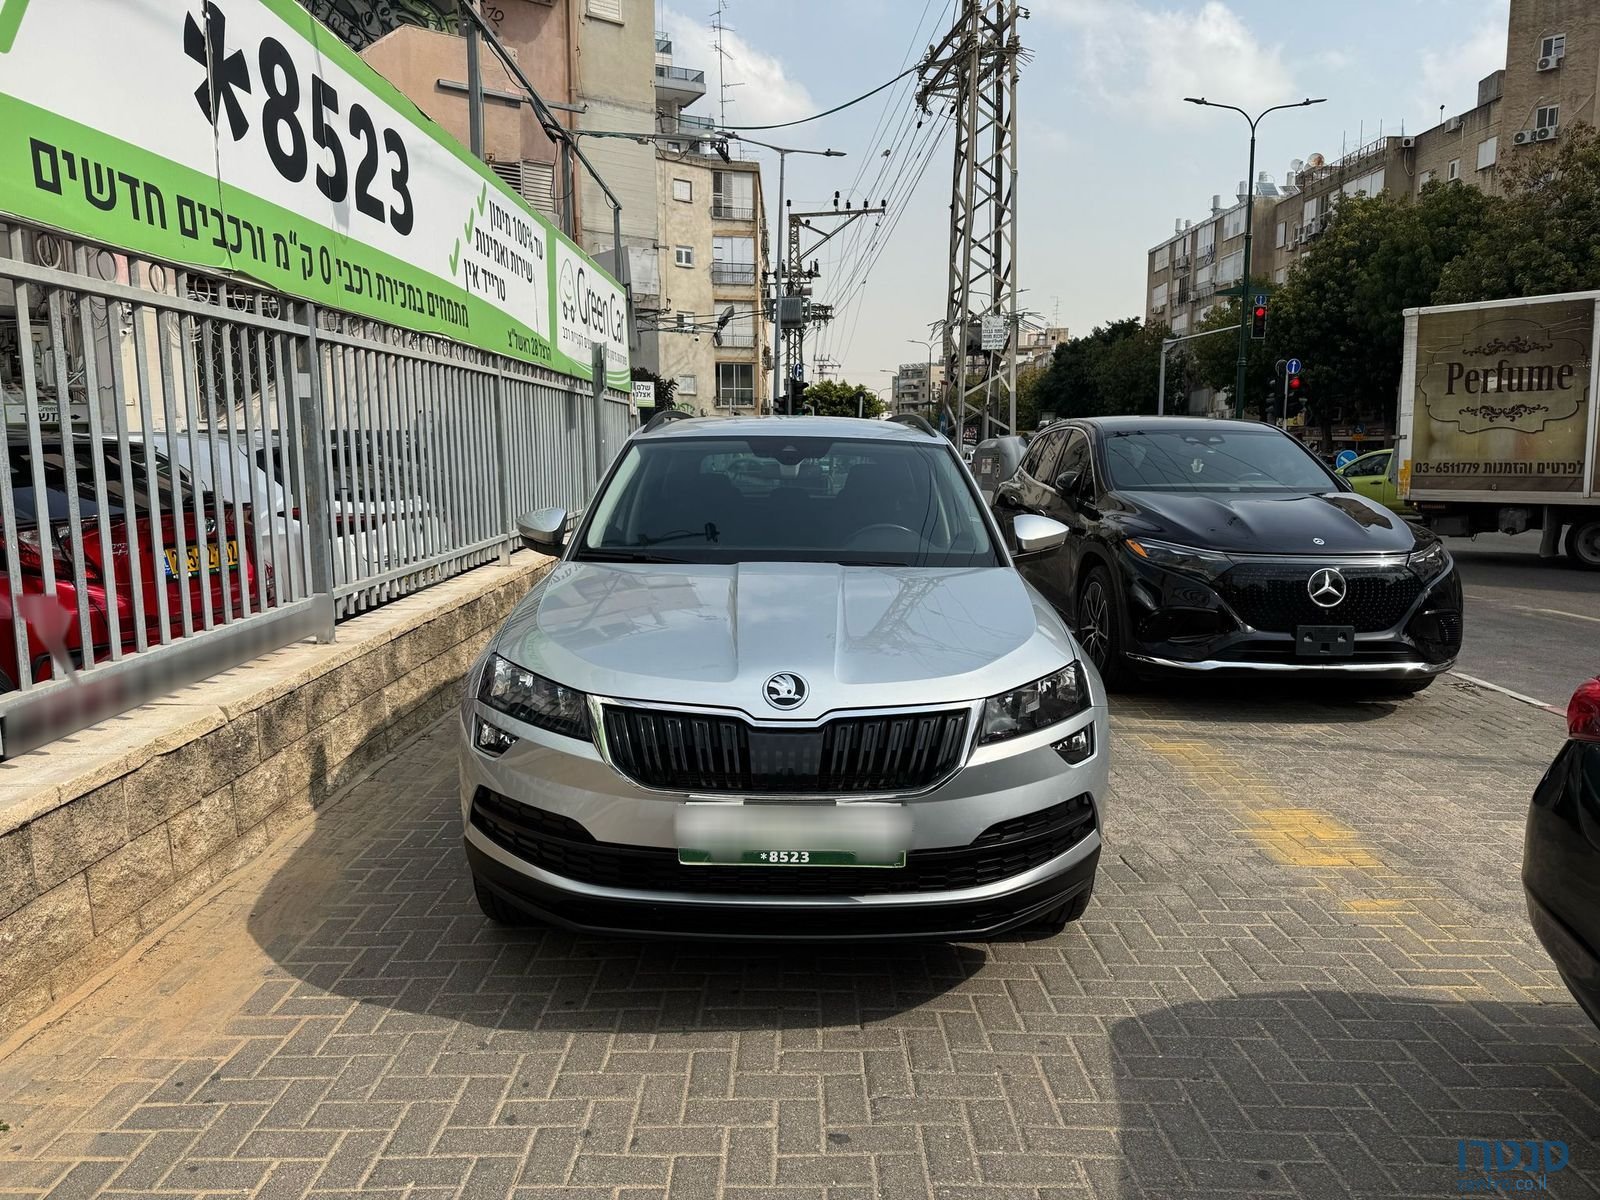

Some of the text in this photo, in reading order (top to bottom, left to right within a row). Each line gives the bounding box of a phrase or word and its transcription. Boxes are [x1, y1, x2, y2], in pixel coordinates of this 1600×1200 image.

[29, 136, 167, 229] חדשים
[176, 194, 266, 262] ורכבים
[488, 199, 511, 237] מימון
[475, 226, 533, 283] שירות ואמינות
[534, 235, 543, 260] עד
[335, 257, 373, 298] רכבי
[375, 272, 425, 314] במכירת
[463, 258, 505, 301] טרייד אין
[427, 291, 469, 328] מתמחים
[576, 267, 625, 345] Green Car
[1444, 359, 1574, 396] Perfume
[1415, 461, 1585, 474] לפרטים והזמנות 03-6511779
